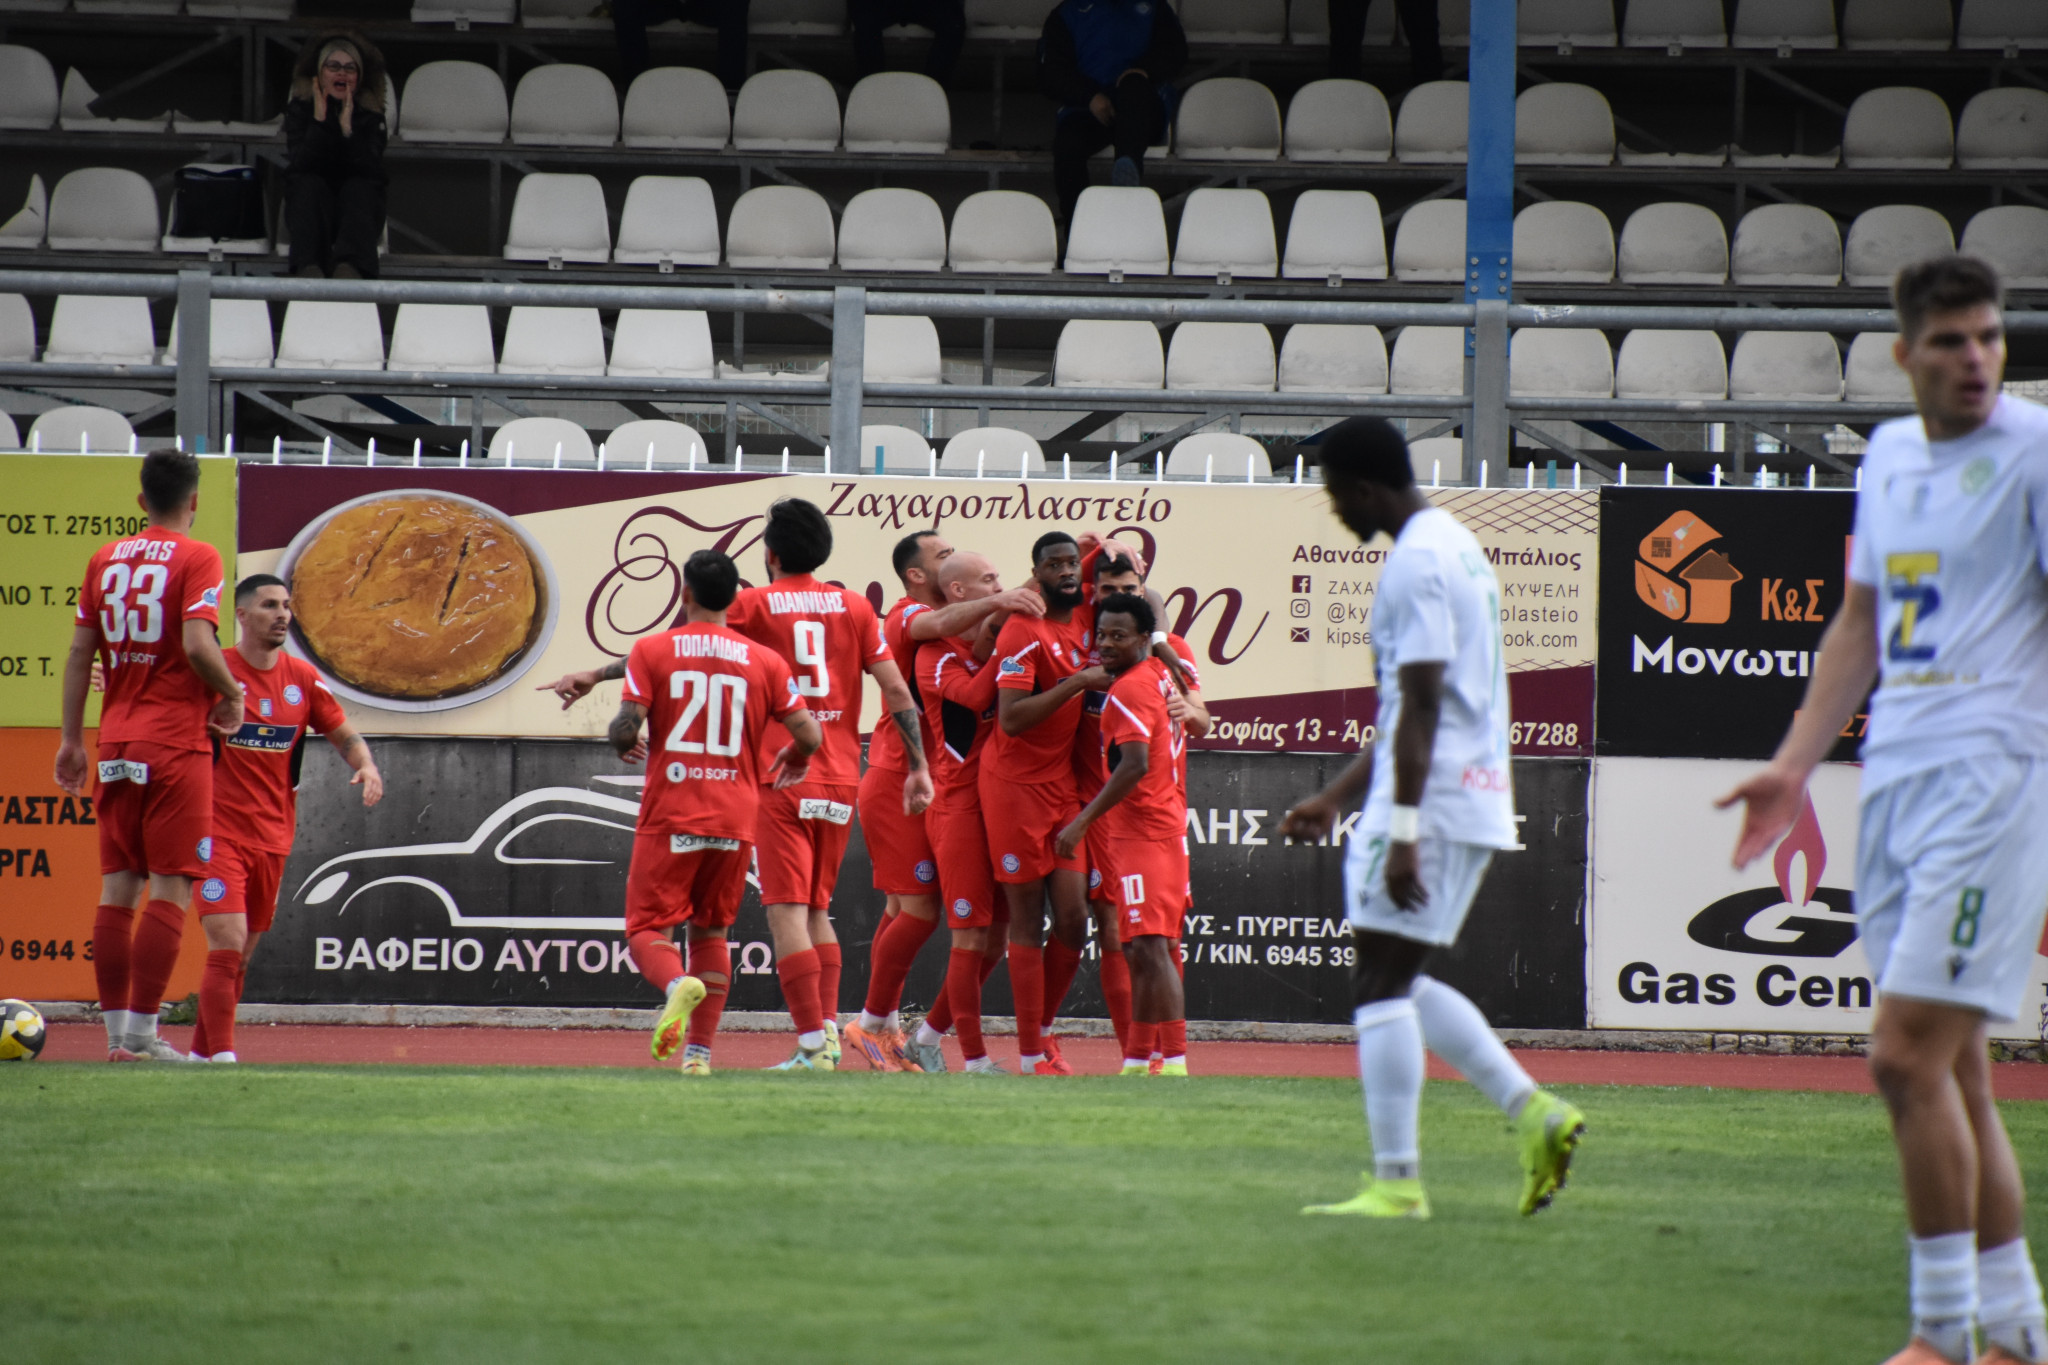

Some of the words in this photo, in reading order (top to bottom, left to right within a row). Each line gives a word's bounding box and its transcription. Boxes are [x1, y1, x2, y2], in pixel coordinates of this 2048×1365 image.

[825, 482, 1172, 530] Ζαχαροπλαστείο
[0, 514, 36, 534] ΟΣ
[1483, 547, 1582, 571] Μπάλιος
[99, 562, 168, 643] 33
[1504, 583, 1579, 598] ΚΥΨΕΛΗ
[130, 652, 157, 666] SOFT
[673, 634, 750, 665] ΤΟΠΑΛΙΔΗΣ
[794, 620, 830, 697] 9
[665, 670, 748, 757] 20
[816, 710, 843, 722] SOFT
[231, 737, 262, 747] ANEK
[1203, 716, 1288, 747] Σοφίας
[1295, 718, 1322, 742] 13
[1509, 721, 1579, 746] 67288
[688, 769, 704, 779] IQ
[705, 768, 738, 782] SOFT
[0, 796, 96, 825] ΑΣΤΑΣ
[1121, 873, 1146, 906] 10
[1952, 886, 1985, 948] 8
[11, 940, 75, 961] 6944
[314, 937, 484, 972] ΒΑΦΕΙΟ
[1210, 944, 1260, 965] ΚΙΝ.
[1266, 945, 1323, 966] 6945
[1617, 961, 1737, 1006] Gas
[1756, 964, 1872, 1007] Cen
